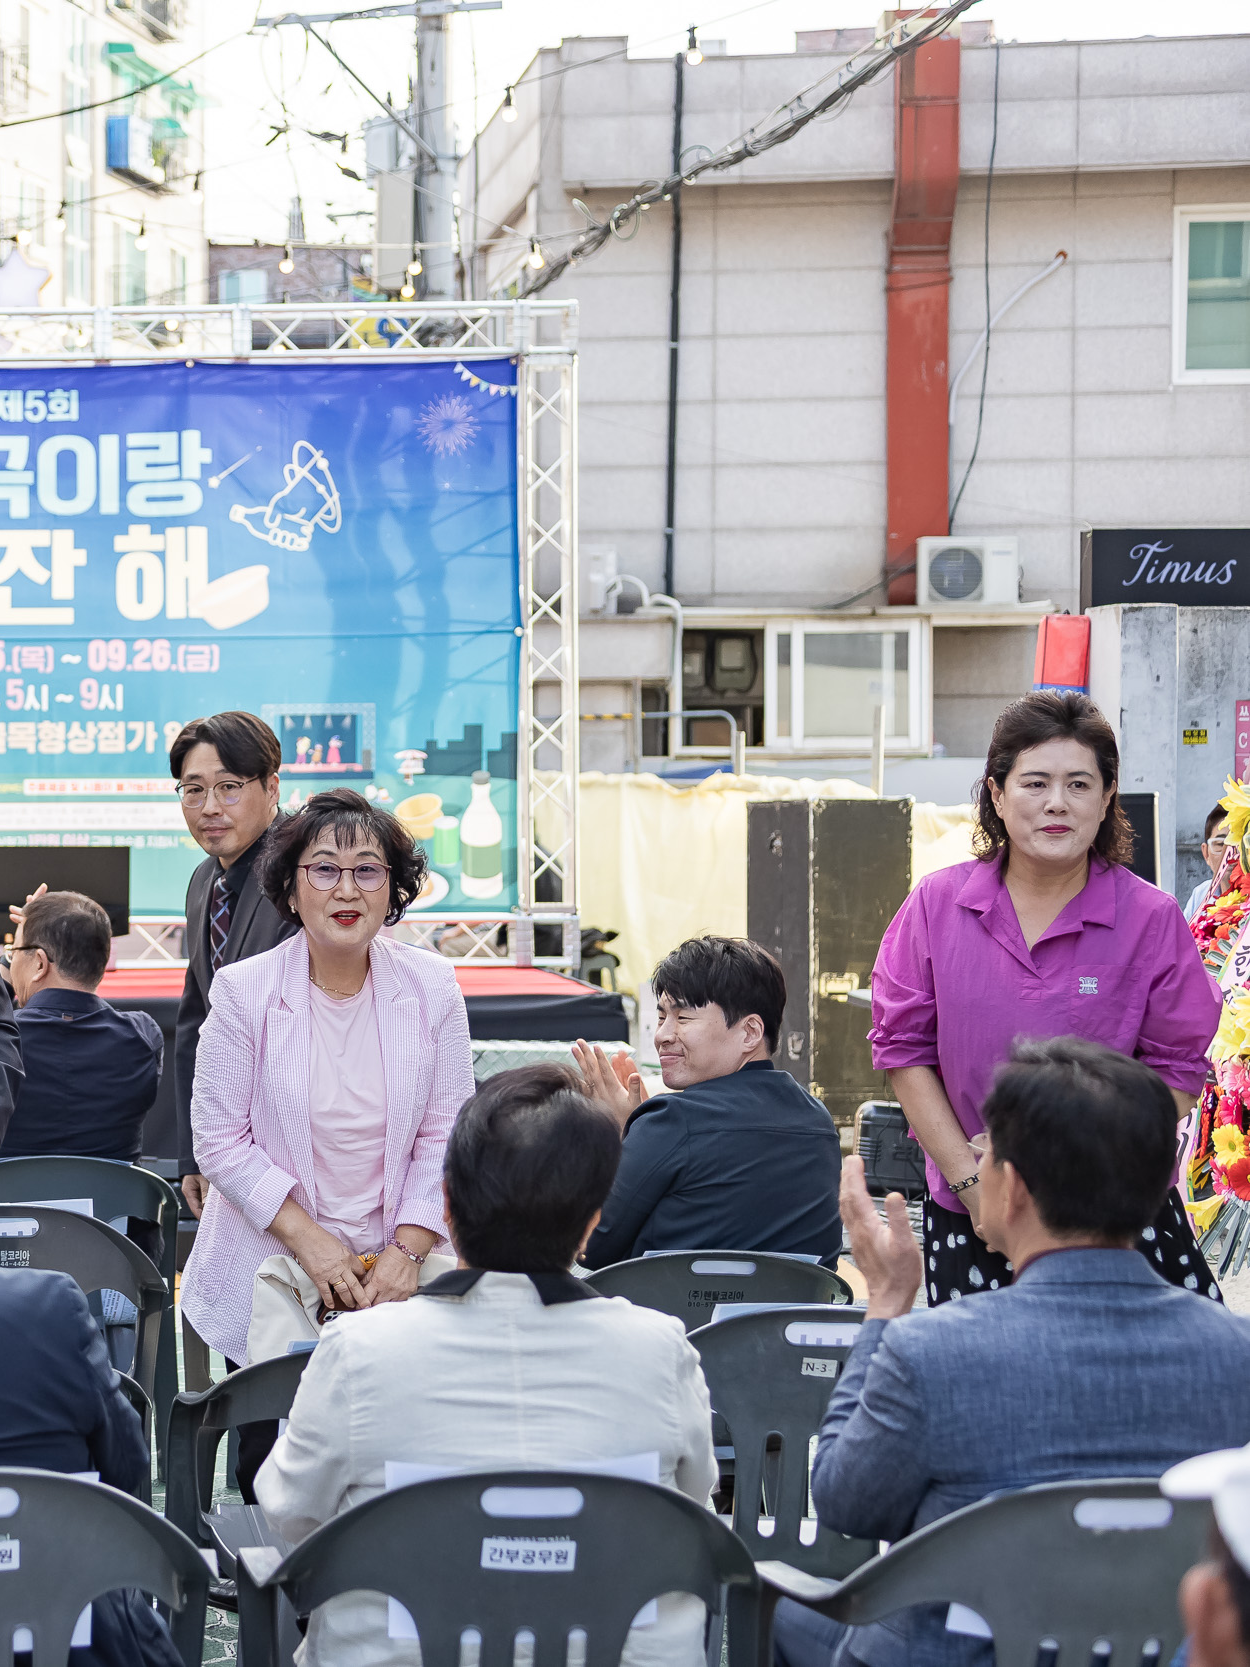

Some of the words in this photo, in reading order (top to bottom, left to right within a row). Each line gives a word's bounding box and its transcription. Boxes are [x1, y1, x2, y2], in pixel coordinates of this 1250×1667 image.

[113, 523, 209, 622] 해
[1122, 540, 1237, 586] Timus
[87, 638, 220, 673] 09.26.(금)
[5, 678, 49, 712] 5시
[79, 678, 124, 712] 9시
[688, 1290, 744, 1301] (주)렌탈코리아
[488, 1546, 569, 1566] 간부공무원
